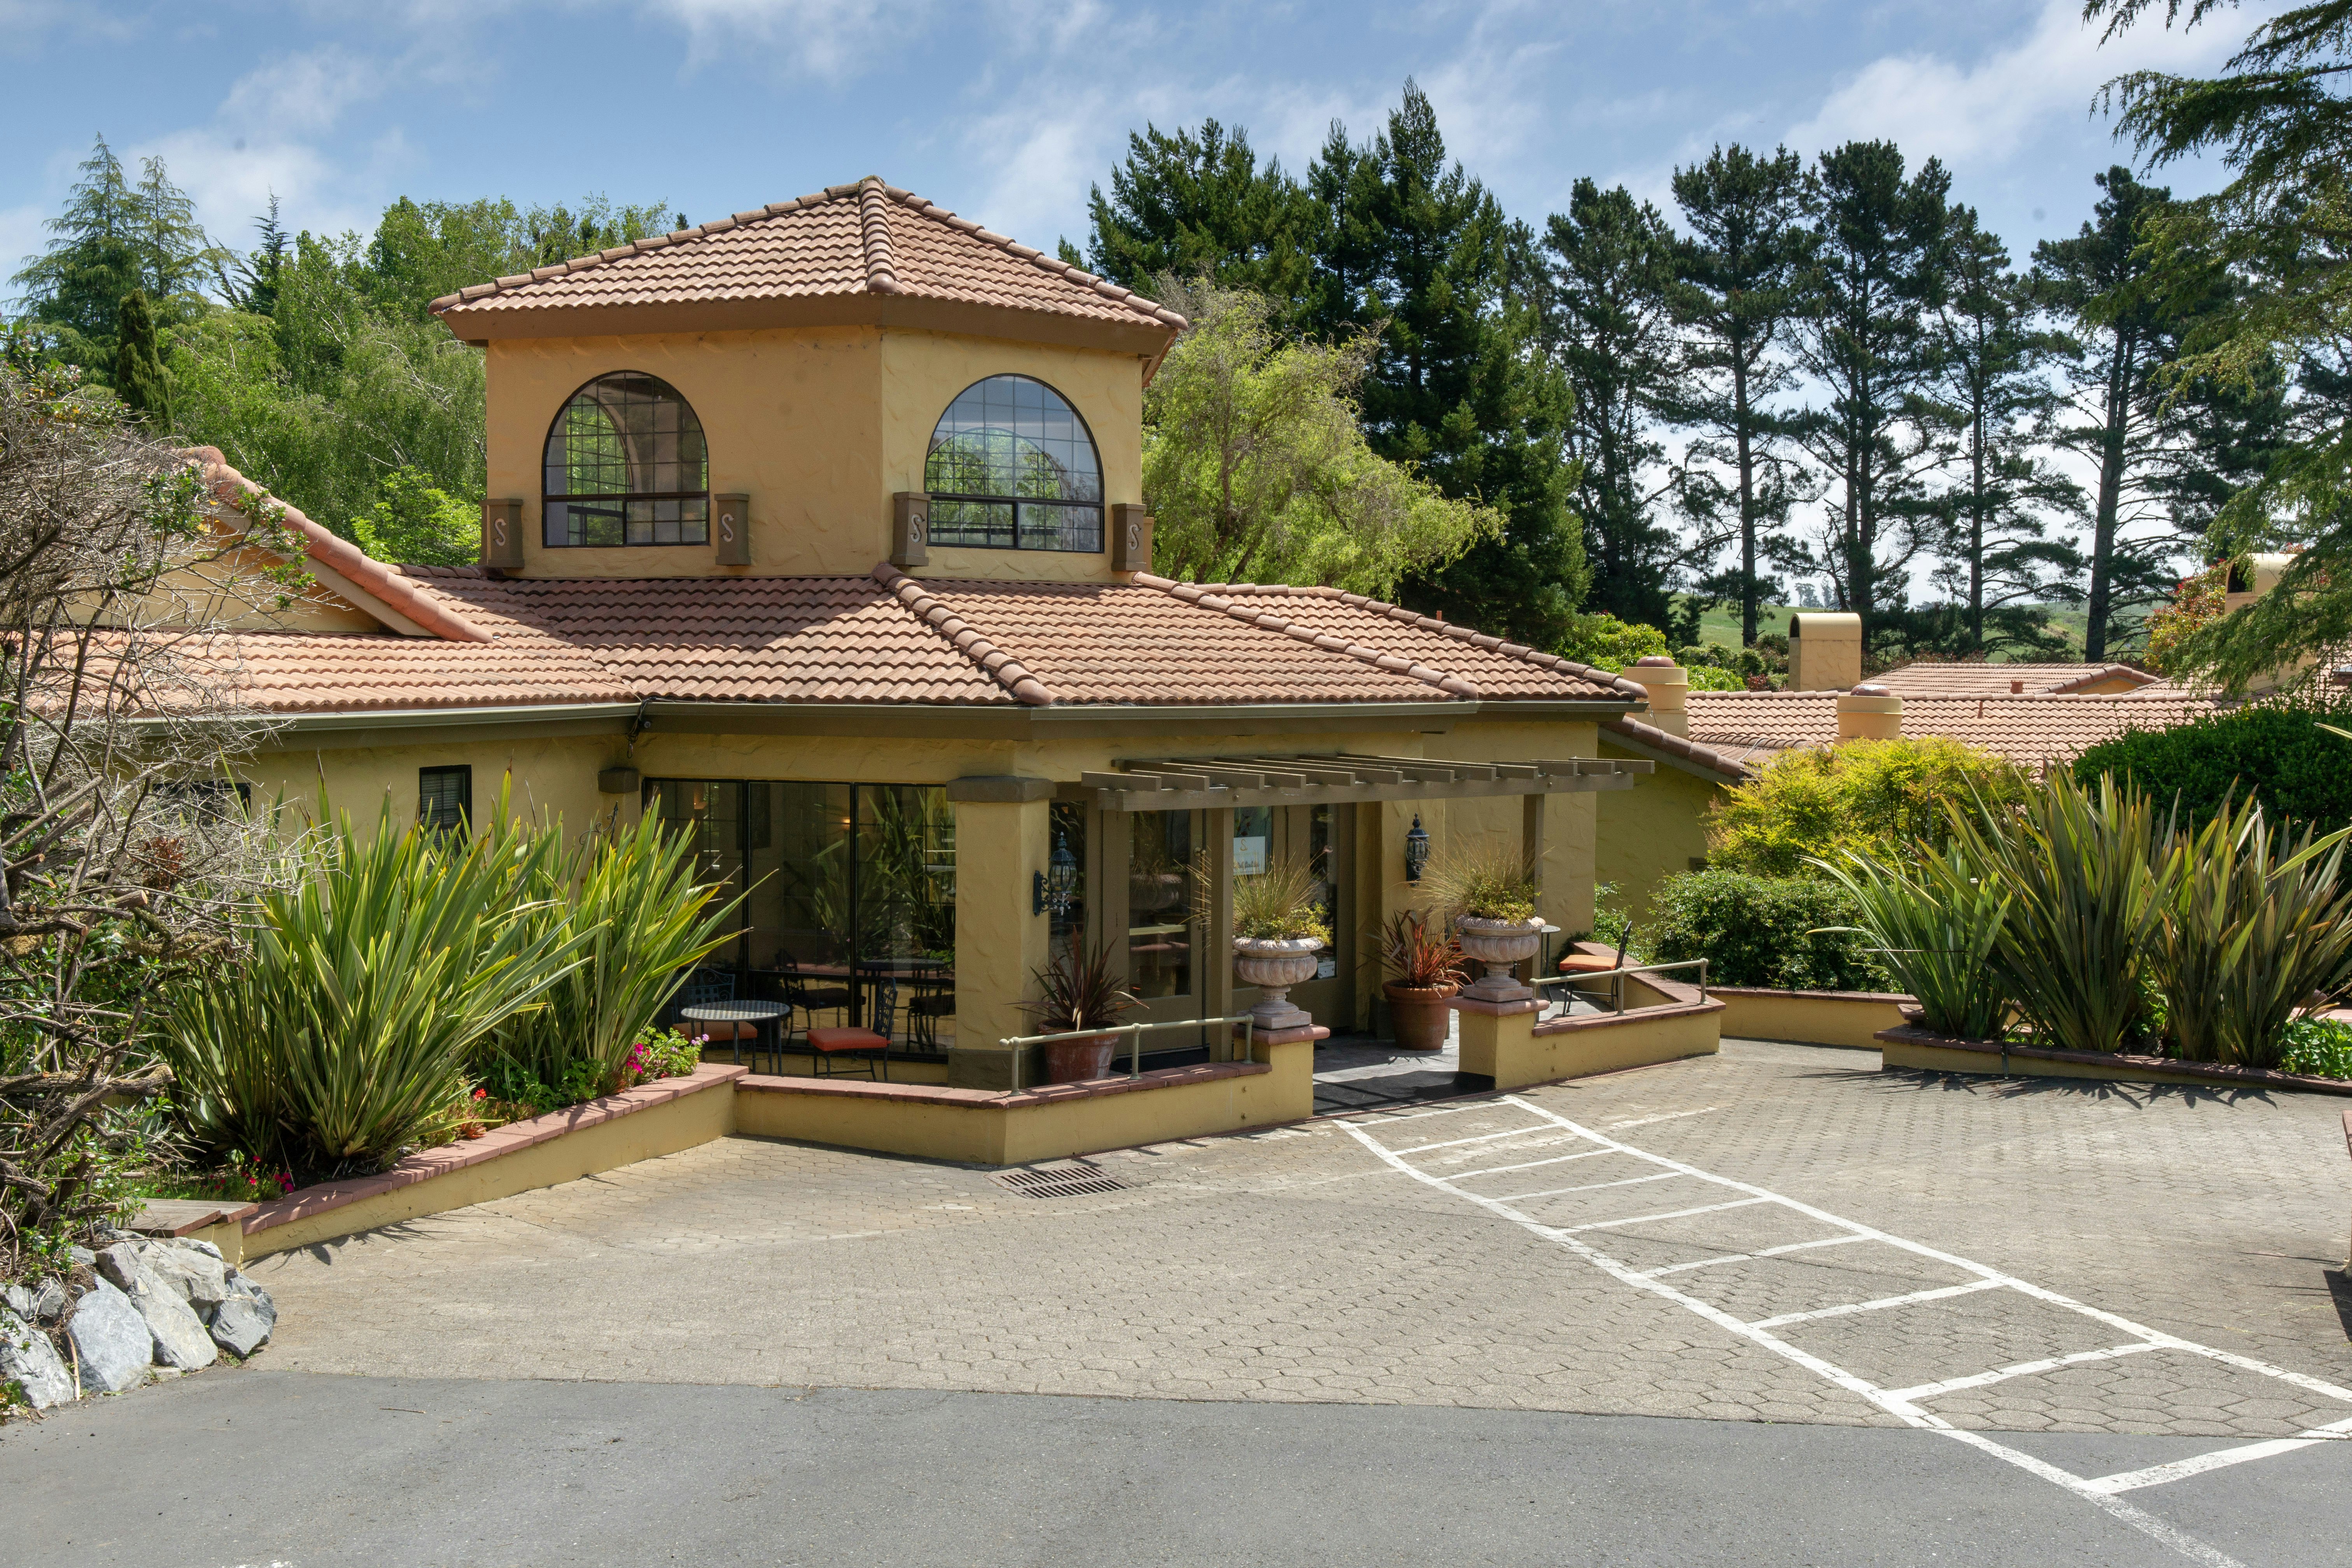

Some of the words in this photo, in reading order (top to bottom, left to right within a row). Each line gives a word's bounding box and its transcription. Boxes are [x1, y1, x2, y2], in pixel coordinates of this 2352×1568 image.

[494, 518, 506, 546] S
[721, 513, 734, 542] S
[911, 513, 925, 542] S
[1129, 523, 1141, 550] S
